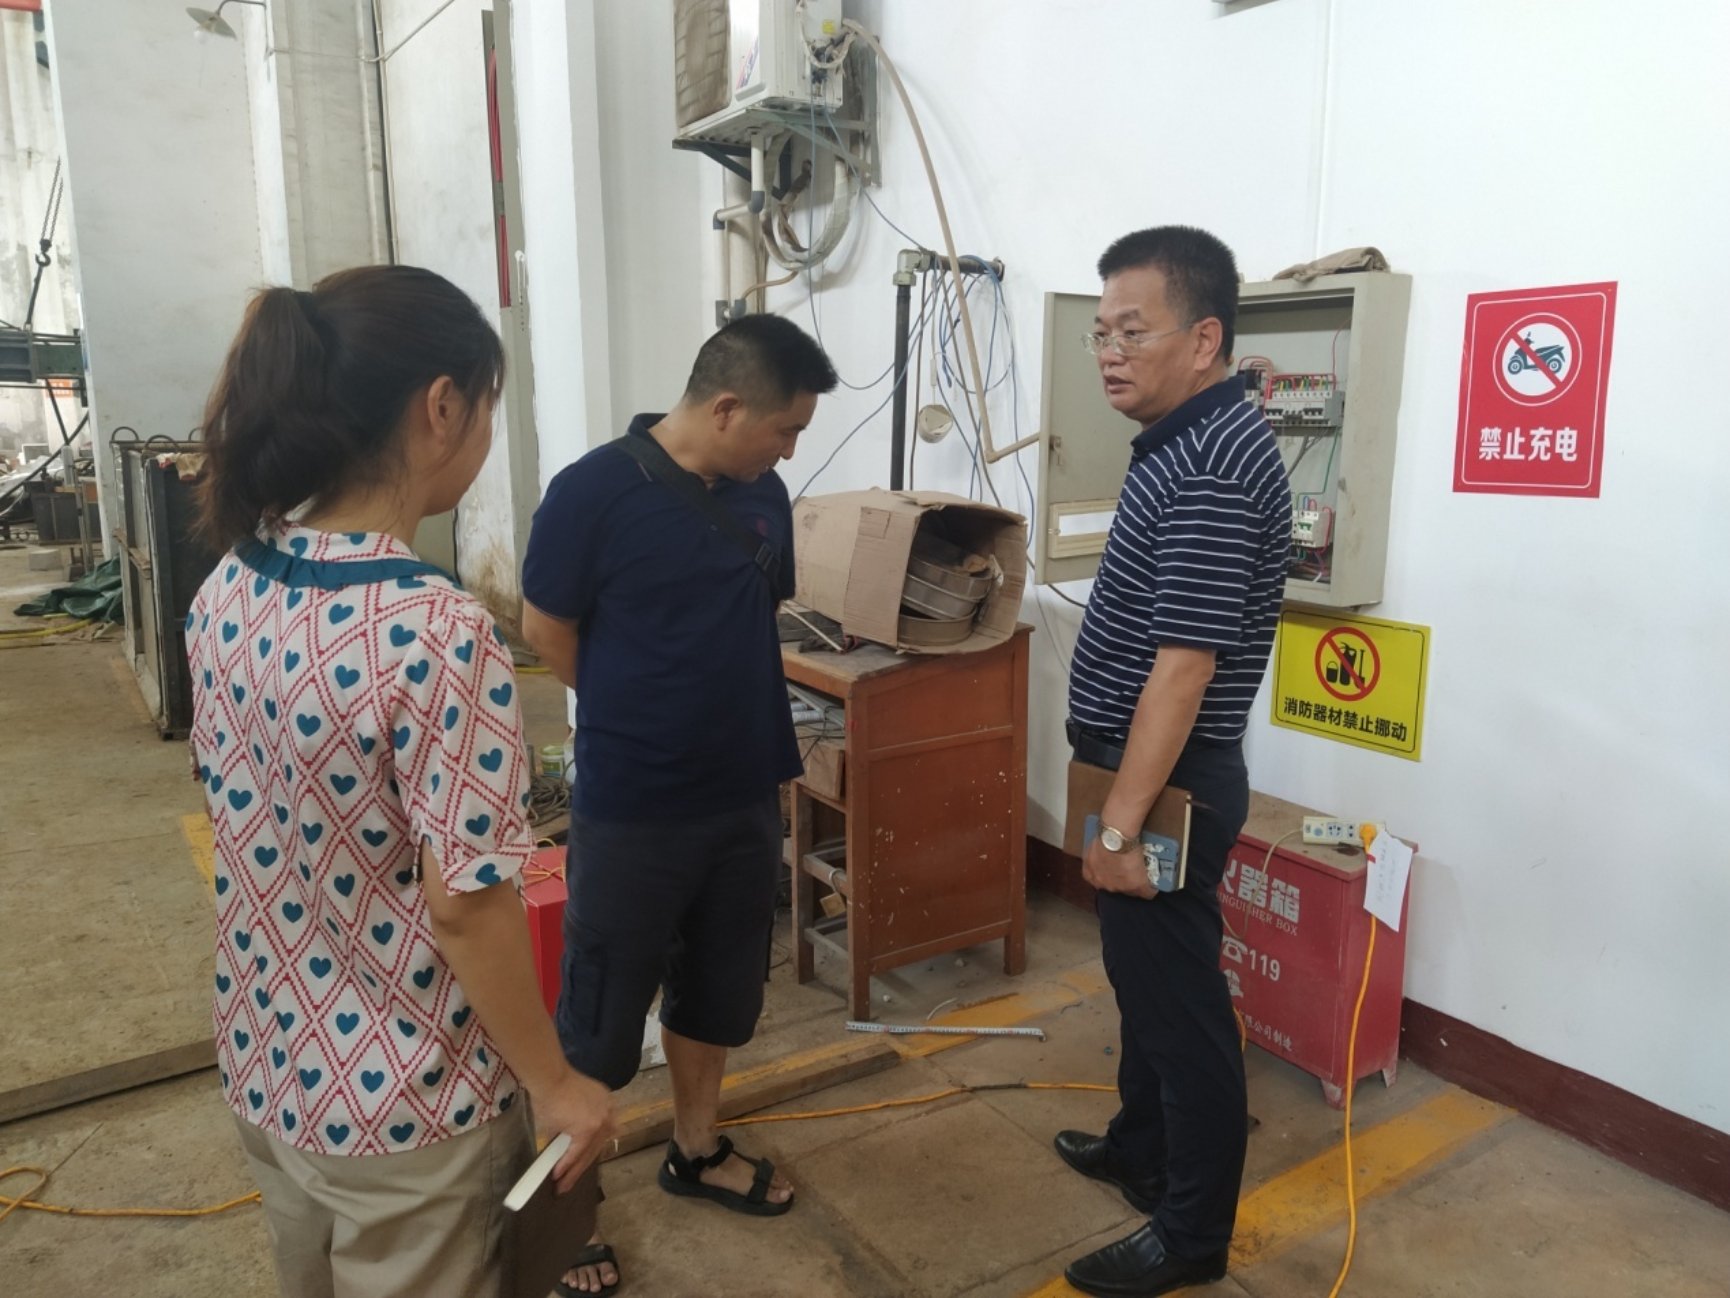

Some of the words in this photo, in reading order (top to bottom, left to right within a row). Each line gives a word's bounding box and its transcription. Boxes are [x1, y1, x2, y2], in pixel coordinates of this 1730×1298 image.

[1479, 427, 1578, 462] 禁止充电
[1284, 696, 1408, 742] 消防器材禁止挪动
[1219, 892, 1273, 925] INGUIHER
[1276, 917, 1299, 937] BOX
[1249, 948, 1281, 981] 119
[1240, 1010, 1293, 1052] 限公司制造
